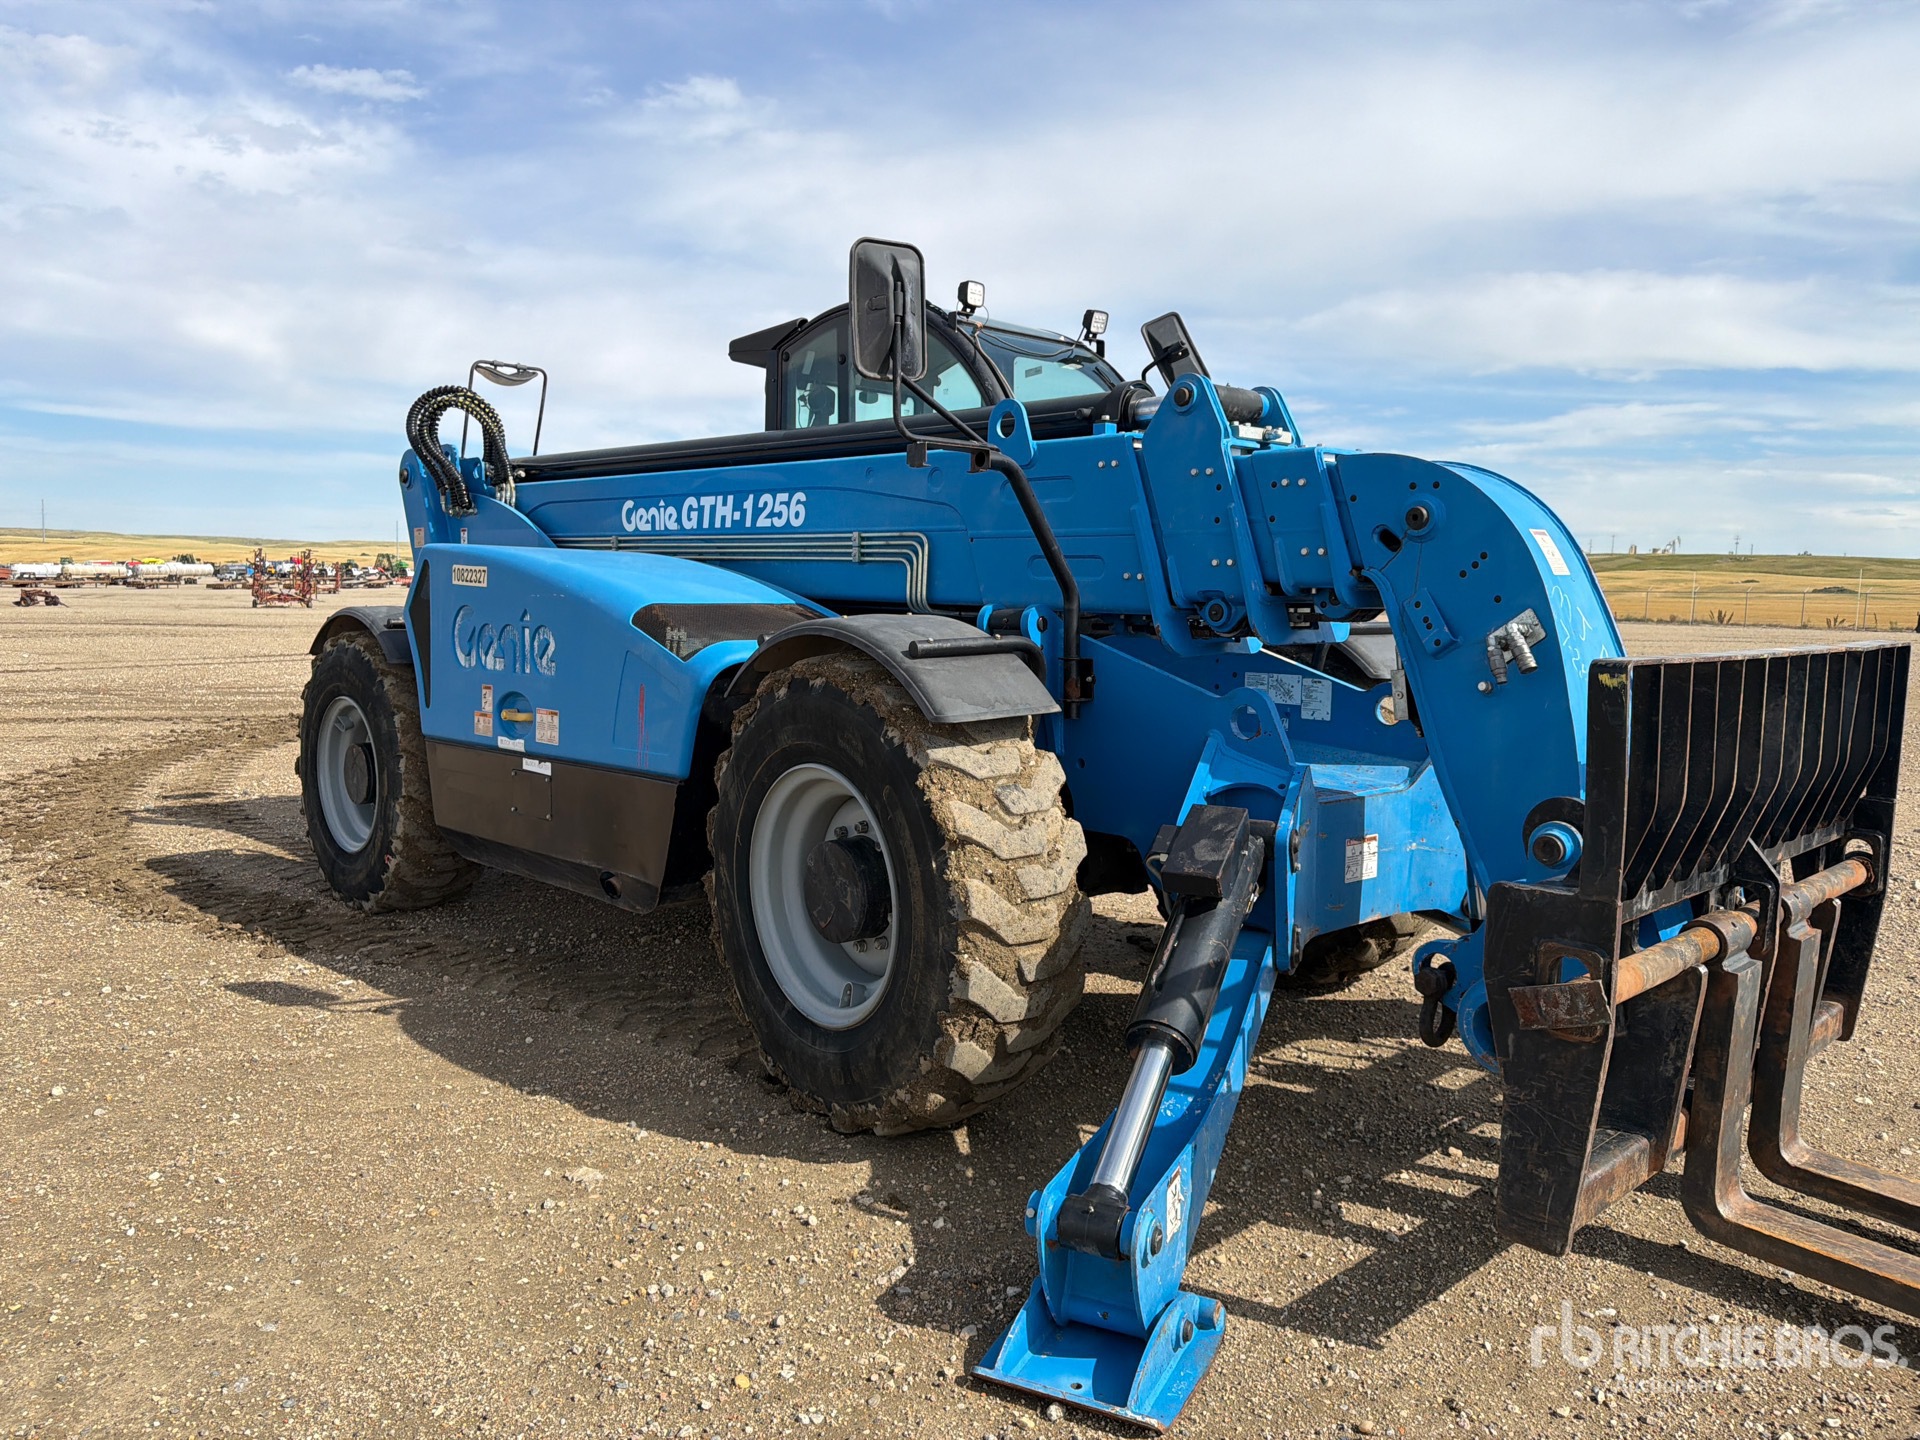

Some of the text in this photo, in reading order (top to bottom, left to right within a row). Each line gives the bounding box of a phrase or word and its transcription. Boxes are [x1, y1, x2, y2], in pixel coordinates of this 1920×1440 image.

[621, 491, 807, 532] Genie GTH-1256
[453, 567, 486, 584] 10822327
[453, 604, 556, 676] Genie
